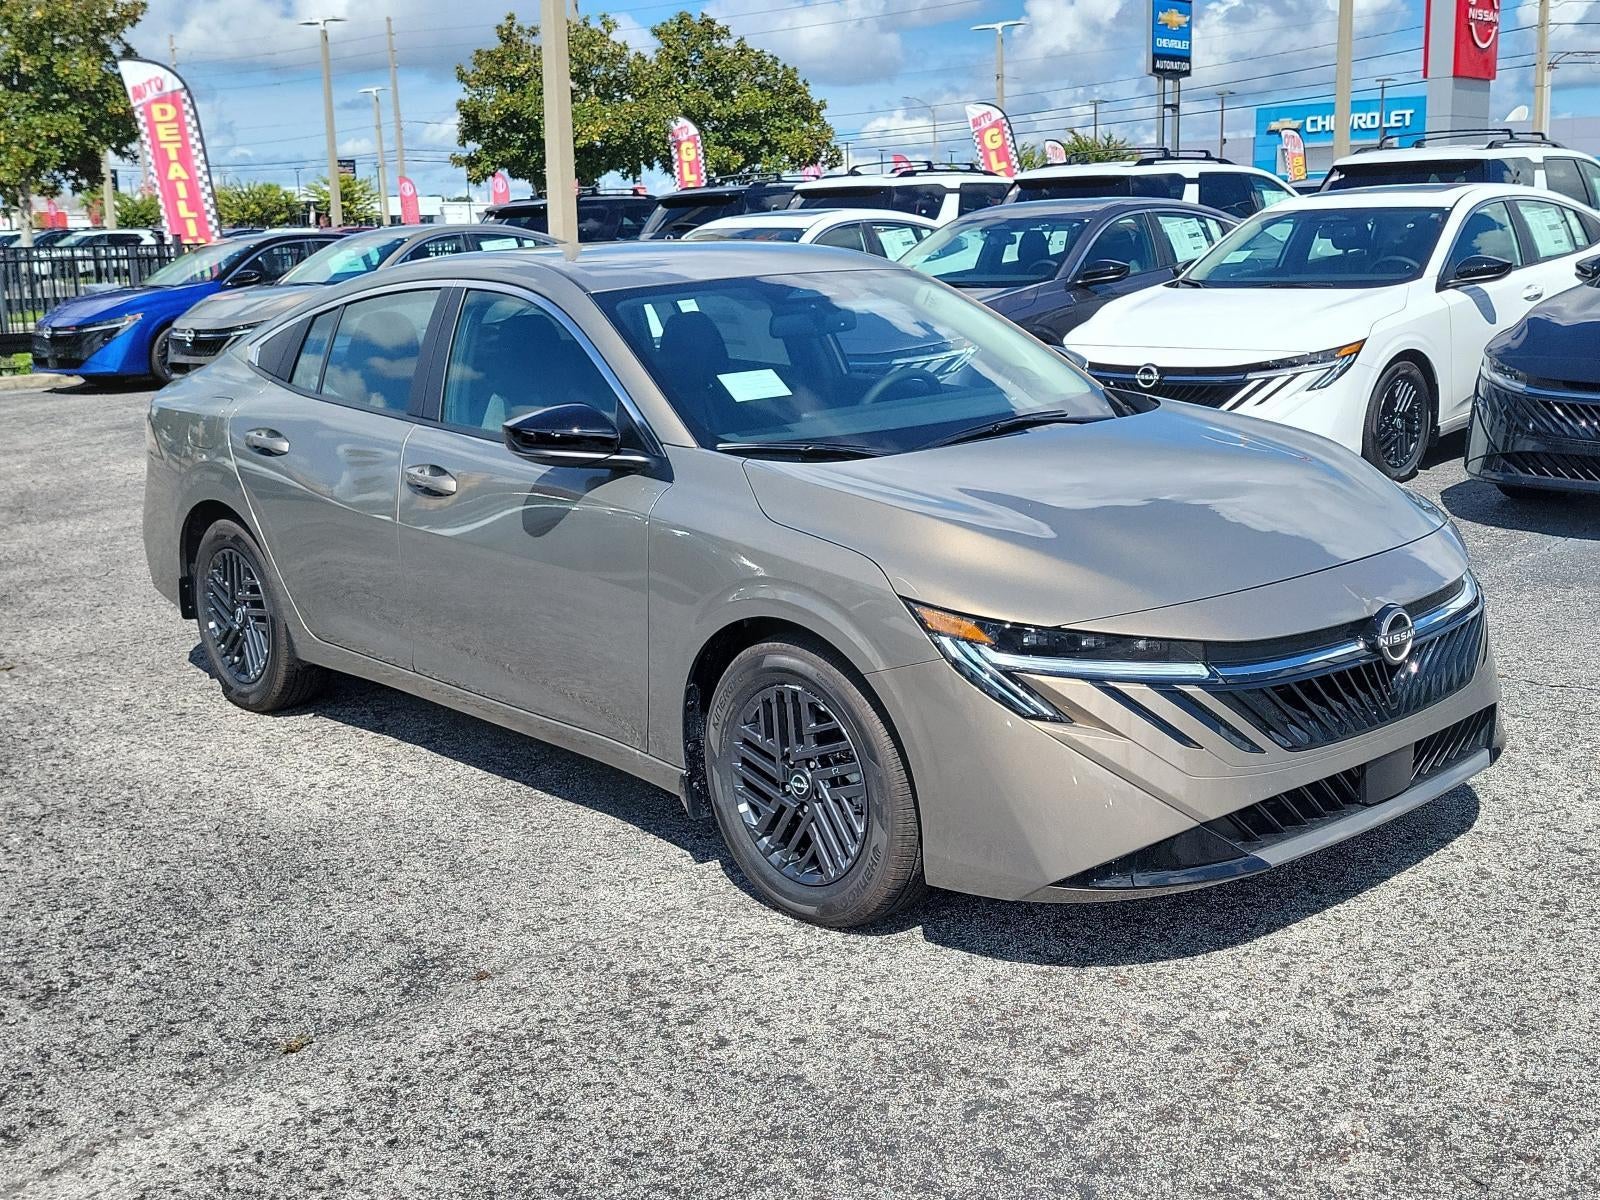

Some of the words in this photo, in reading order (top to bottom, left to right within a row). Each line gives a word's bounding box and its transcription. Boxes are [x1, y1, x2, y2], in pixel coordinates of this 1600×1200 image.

[1468, 7, 1499, 22] NISSAN
[1156, 37, 1190, 50] CHEVROLET
[1155, 59, 1190, 71] AUTONATION
[131, 76, 165, 103] AUTO
[1306, 109, 1415, 133] CHROLET
[984, 127, 1009, 177] GL
[151, 102, 207, 244] DETAILI
[680, 141, 698, 188] GL
[1379, 627, 1416, 647] NISSAN
